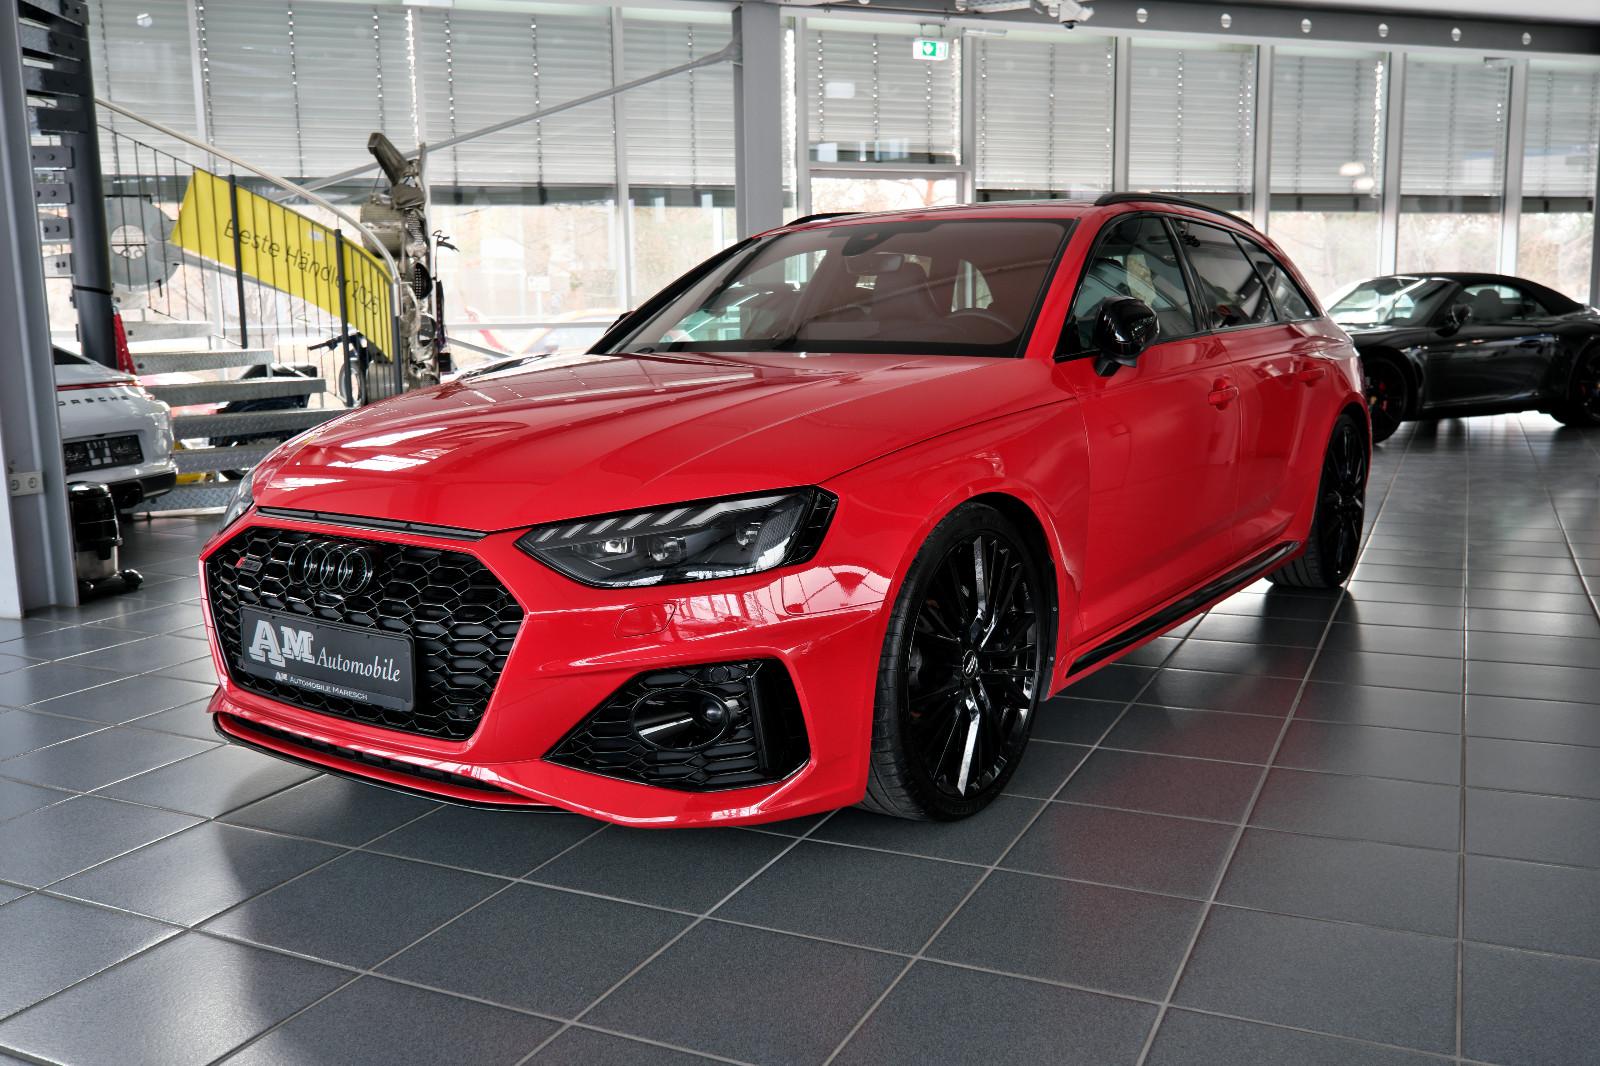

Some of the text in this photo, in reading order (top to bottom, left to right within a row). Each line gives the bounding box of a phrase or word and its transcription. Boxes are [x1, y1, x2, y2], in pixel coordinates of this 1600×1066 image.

[56, 395, 129, 406] ORSCHE
[248, 619, 401, 682] AM Automobile
[289, 676, 331, 693] AUTOMOBILE
[332, 686, 368, 700] MARESCH
